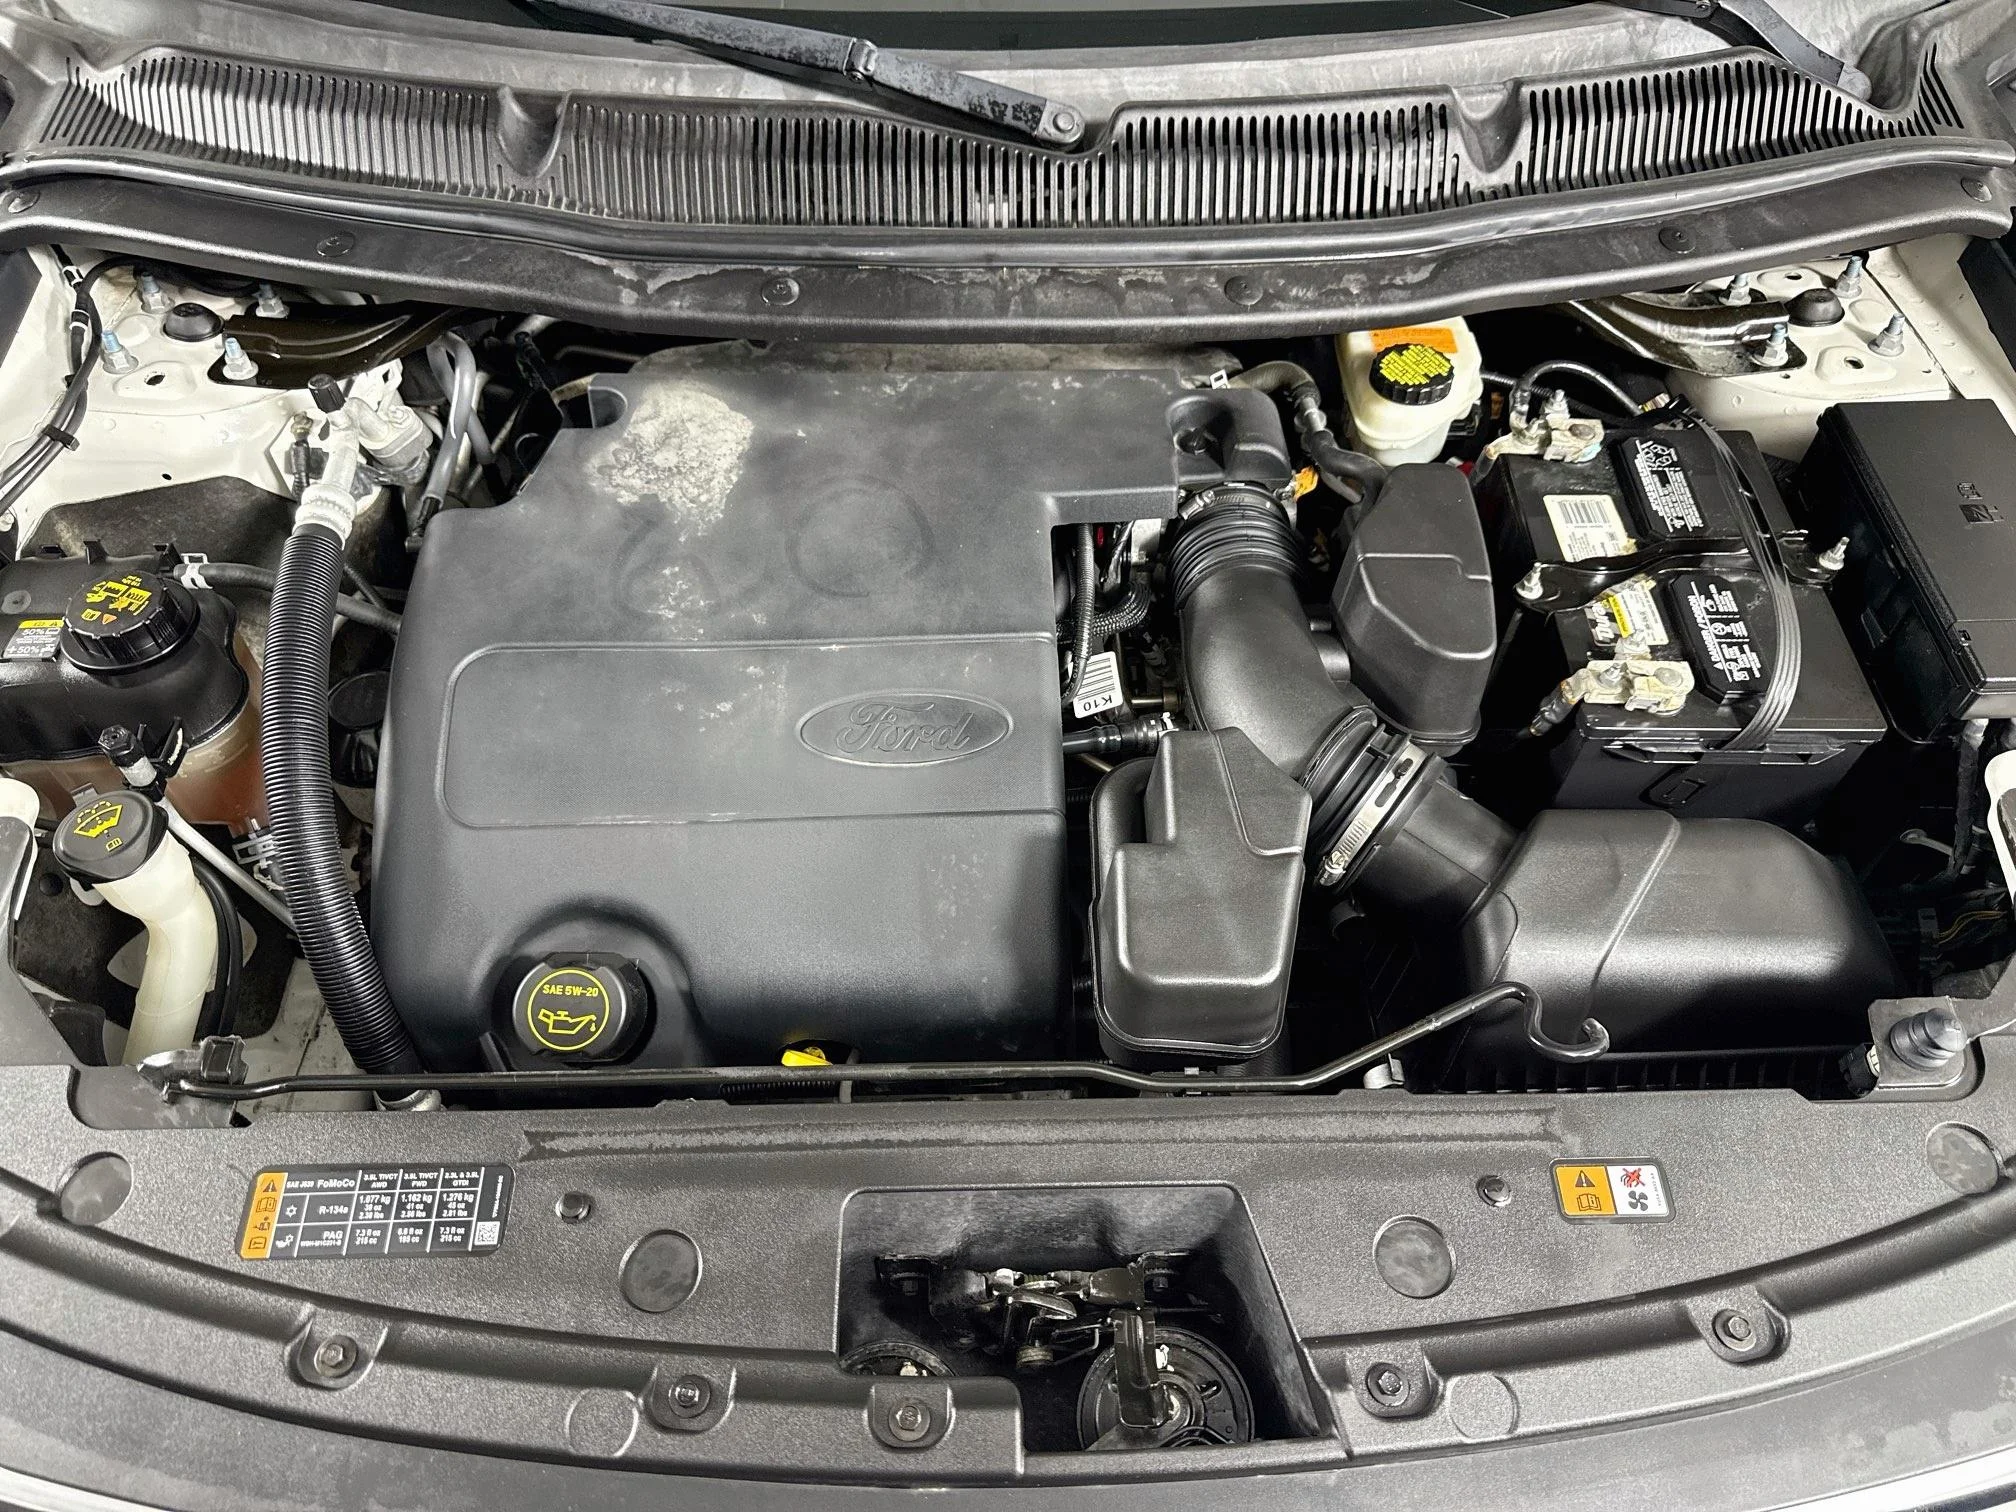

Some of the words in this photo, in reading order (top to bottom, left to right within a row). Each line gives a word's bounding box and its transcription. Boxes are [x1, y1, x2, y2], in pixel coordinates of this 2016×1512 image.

[1083, 695, 1112, 711] K10
[836, 702, 975, 753] Ford
[542, 984, 563, 995] SAE
[565, 985, 599, 997] 5W-20
[317, 1178, 355, 1188] FoMoCo
[360, 1194, 379, 1203] 1.077
[381, 1194, 391, 1205] kg
[422, 1193, 432, 1203] kg
[464, 1193, 474, 1203] kg
[319, 1205, 349, 1214] R-134a
[323, 1230, 343, 1240] PAG
